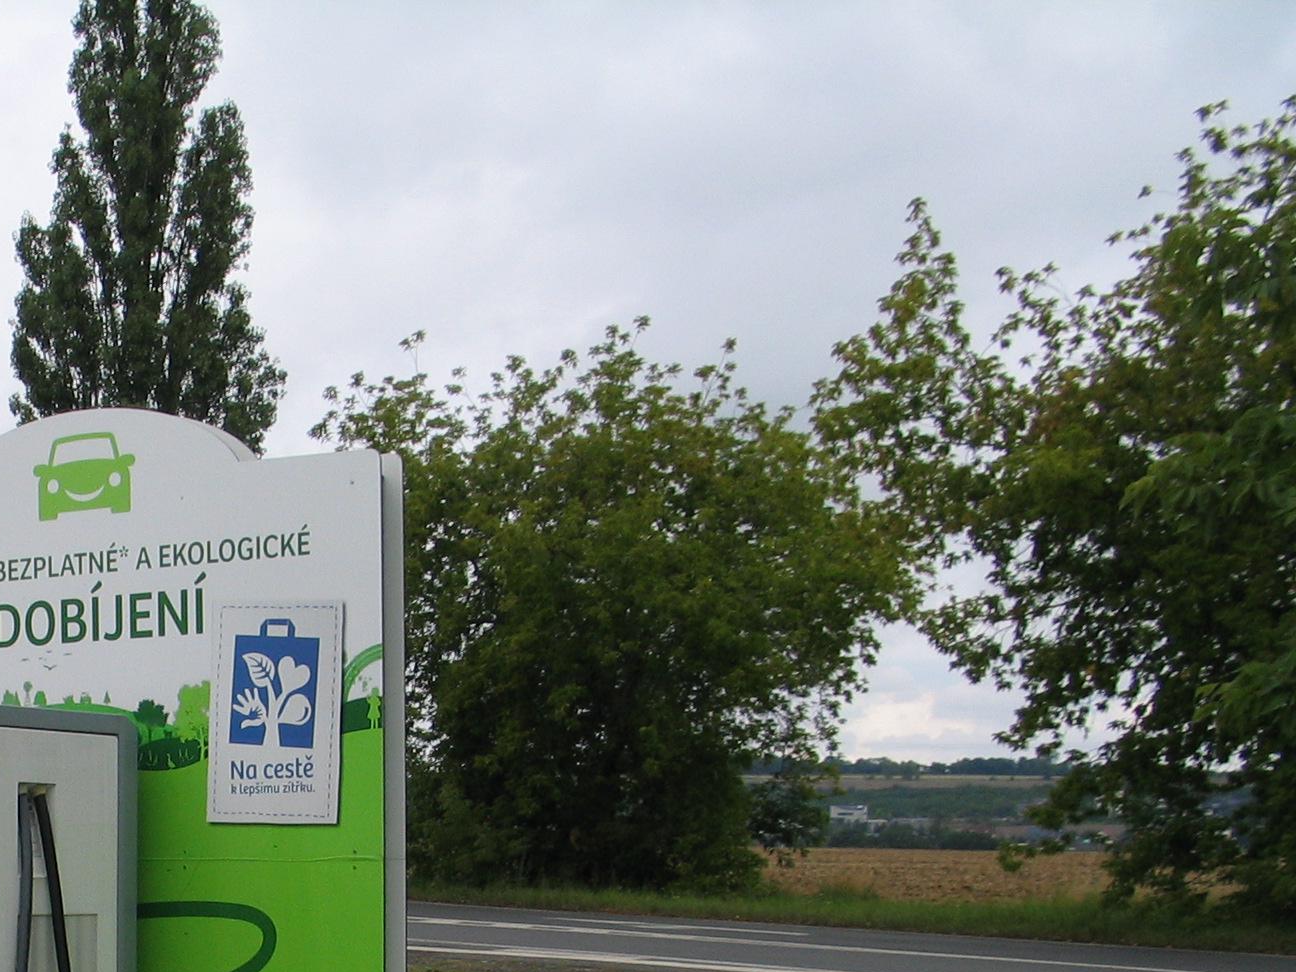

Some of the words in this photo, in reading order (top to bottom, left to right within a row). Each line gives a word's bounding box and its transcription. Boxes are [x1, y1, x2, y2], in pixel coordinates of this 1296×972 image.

[135, 547, 152, 571] A
[159, 524, 311, 568] EKOLOGICKÉ
[230, 760, 257, 780] Na
[264, 754, 314, 779] cestě
[231, 784, 237, 795] k
[240, 782, 280, 797] lepšímu
